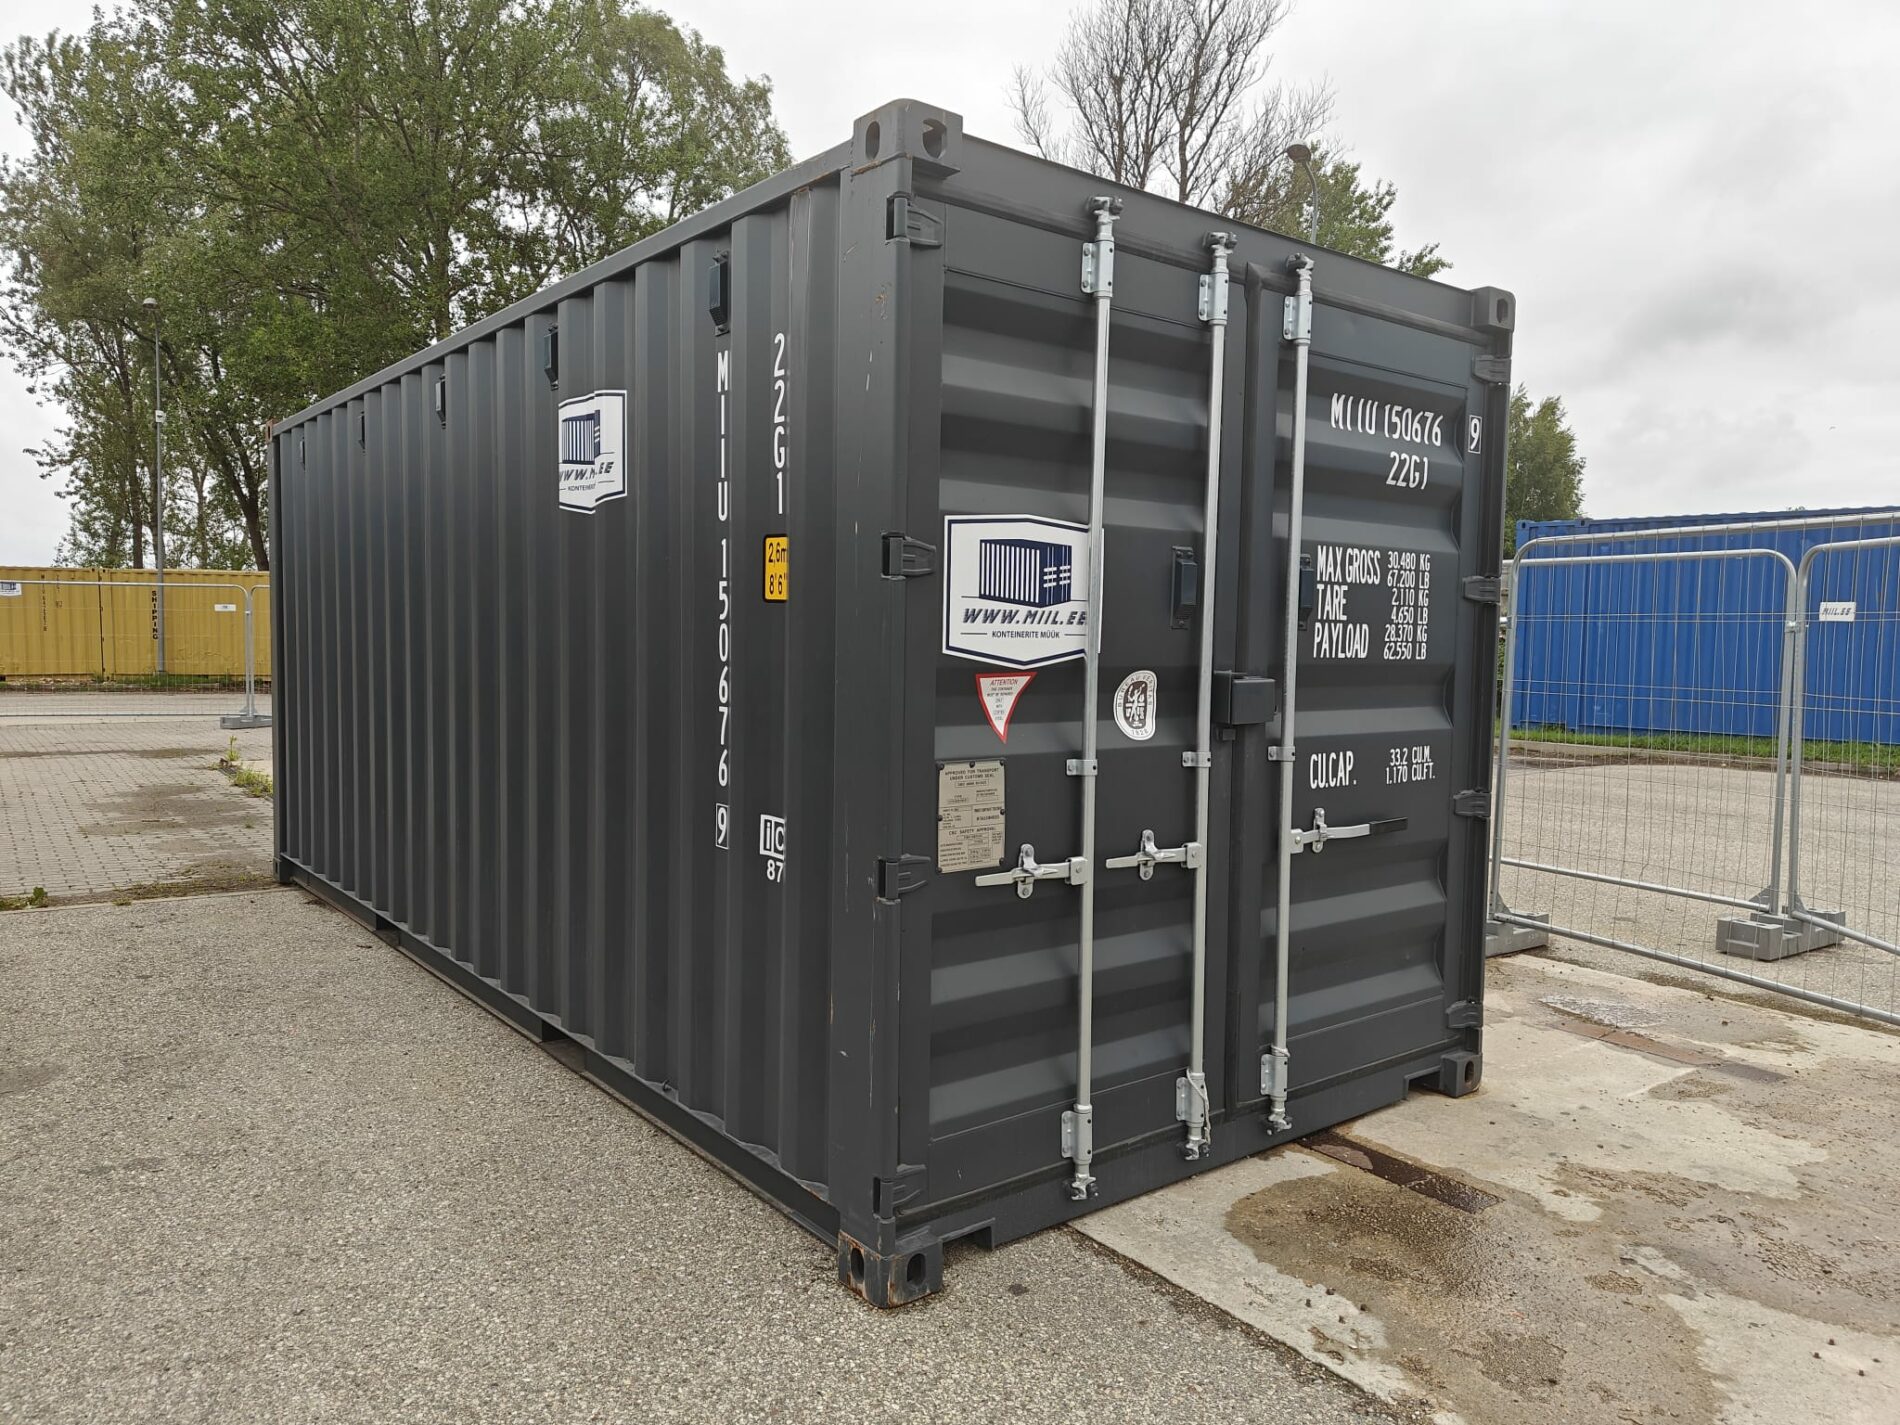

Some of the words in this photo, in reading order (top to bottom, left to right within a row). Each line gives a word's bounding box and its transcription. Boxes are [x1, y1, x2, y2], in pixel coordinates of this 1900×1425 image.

[718, 350, 729, 521] MIIU
[773, 333, 785, 515] 22G1
[1331, 393, 1379, 435] MIIU
[1384, 404, 1444, 447] 150676
[1470, 418, 1480, 450] 9
[1386, 451, 1429, 490] 22G1
[1317, 545, 1343, 583] MAX
[1346, 548, 1381, 585] GROSS
[1387, 551, 1416, 570] 30.480
[1420, 553, 1431, 571] KG
[1387, 570, 1416, 588] 67.200
[1419, 571, 1430, 589] LB
[962, 608, 1087, 626] WWW.MIIL.EE
[1317, 583, 1348, 621] TARE
[1418, 589, 1430, 607] KG
[1417, 607, 1429, 625] LB
[992, 630, 1039, 639] KONTEINERITE
[1040, 629, 1060, 640] MÜÜK
[1313, 622, 1369, 659] PAYLOAD
[1384, 624, 1413, 642] 28.370
[1416, 625, 1428, 642] KG
[1415, 642, 1427, 660] LB
[719, 538, 729, 787] 150676
[1390, 747, 1408, 766] 33.2
[717, 807, 728, 845] 9
[767, 859, 784, 883] 87
